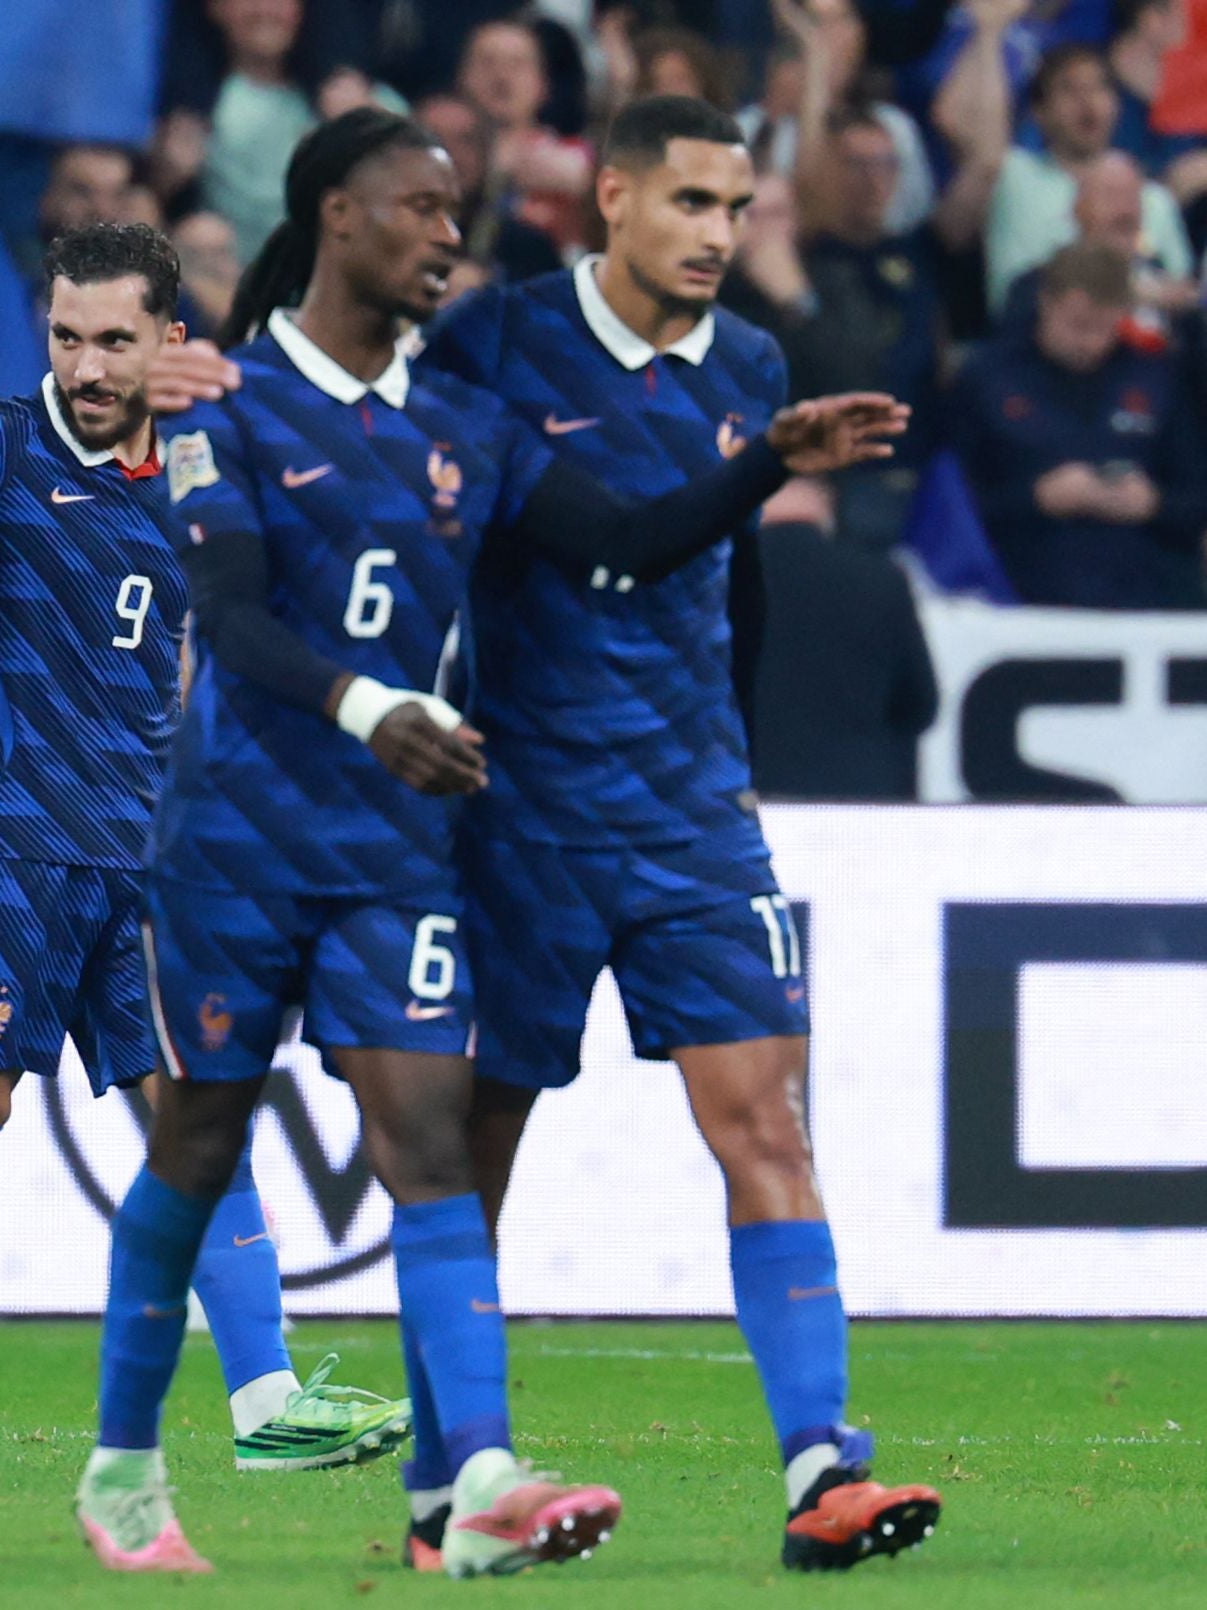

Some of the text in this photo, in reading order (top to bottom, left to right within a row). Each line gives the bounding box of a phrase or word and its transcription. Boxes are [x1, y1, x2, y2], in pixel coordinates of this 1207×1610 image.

[113, 573, 153, 649] 9
[343, 548, 397, 638] 6
[408, 912, 457, 1000] 6
